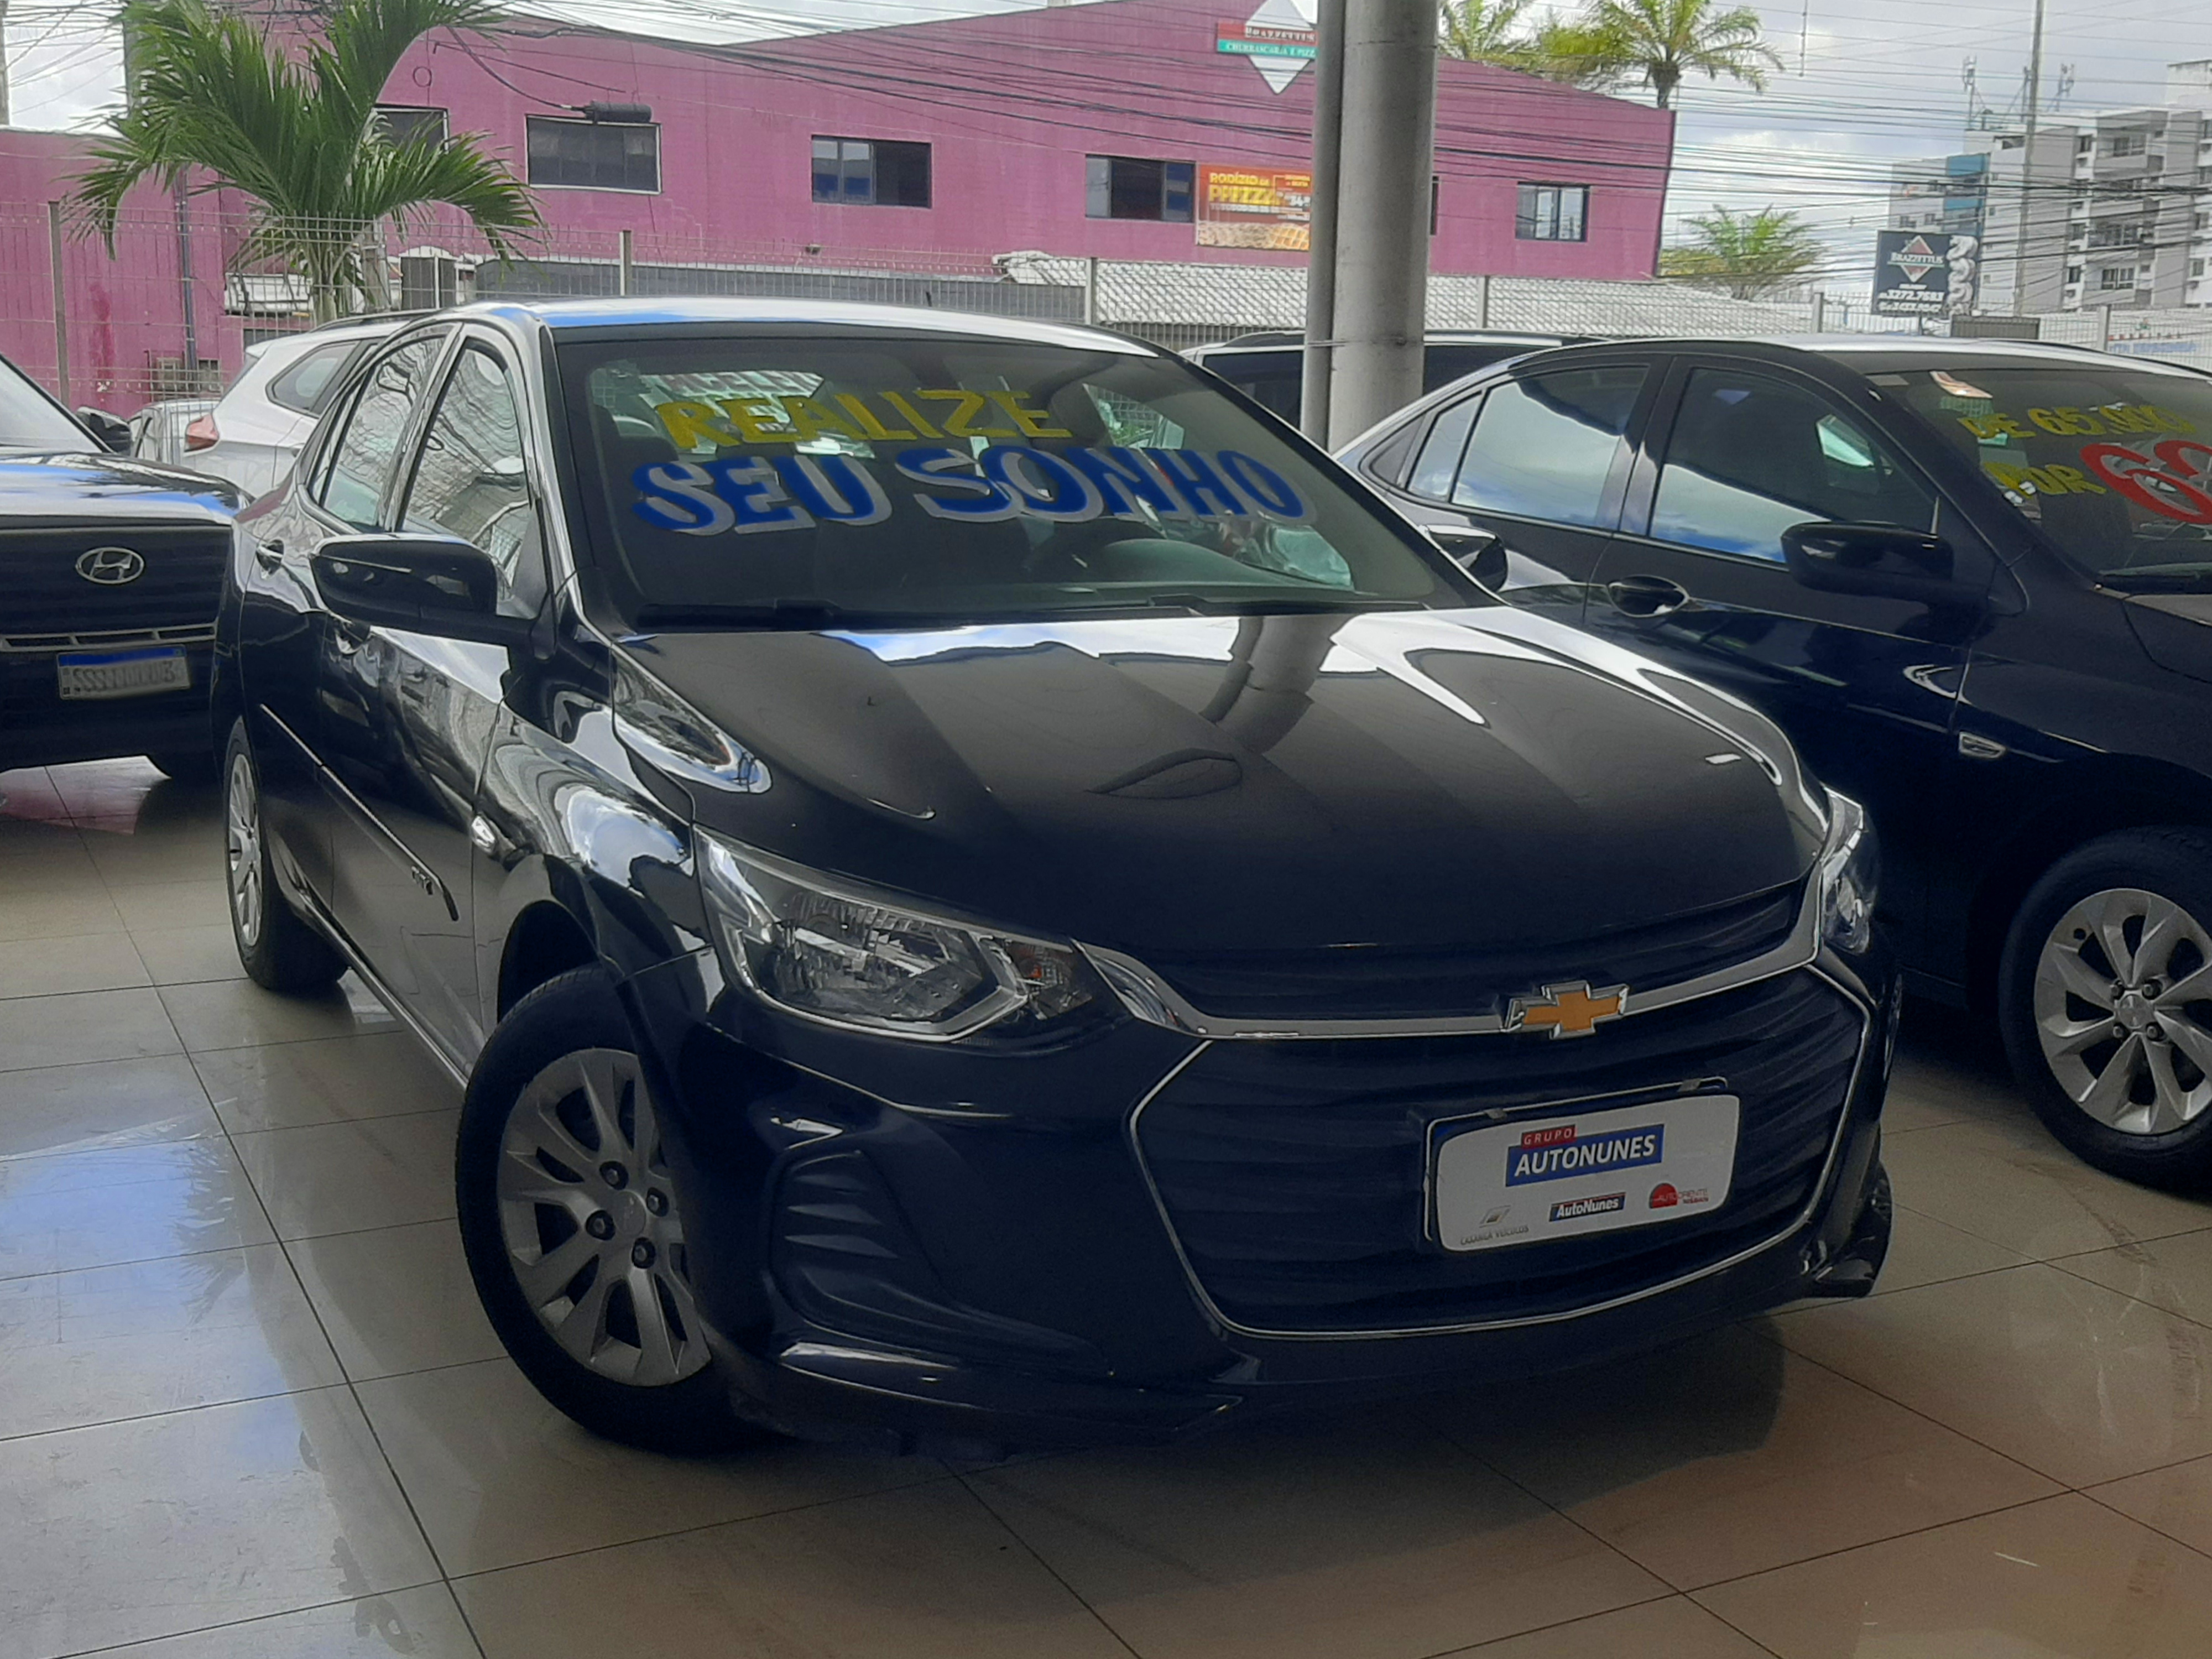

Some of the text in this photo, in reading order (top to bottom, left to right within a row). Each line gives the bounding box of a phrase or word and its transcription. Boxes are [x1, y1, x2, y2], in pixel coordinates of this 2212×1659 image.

[655, 389, 1072, 449] REALIZE
[632, 445, 1317, 535] SEU SONHO
[1514, 1134, 1656, 1177] AUTONUNES
[1524, 1127, 1574, 1146] GRUPO
[1556, 1197, 1619, 1218] AutoNunes
